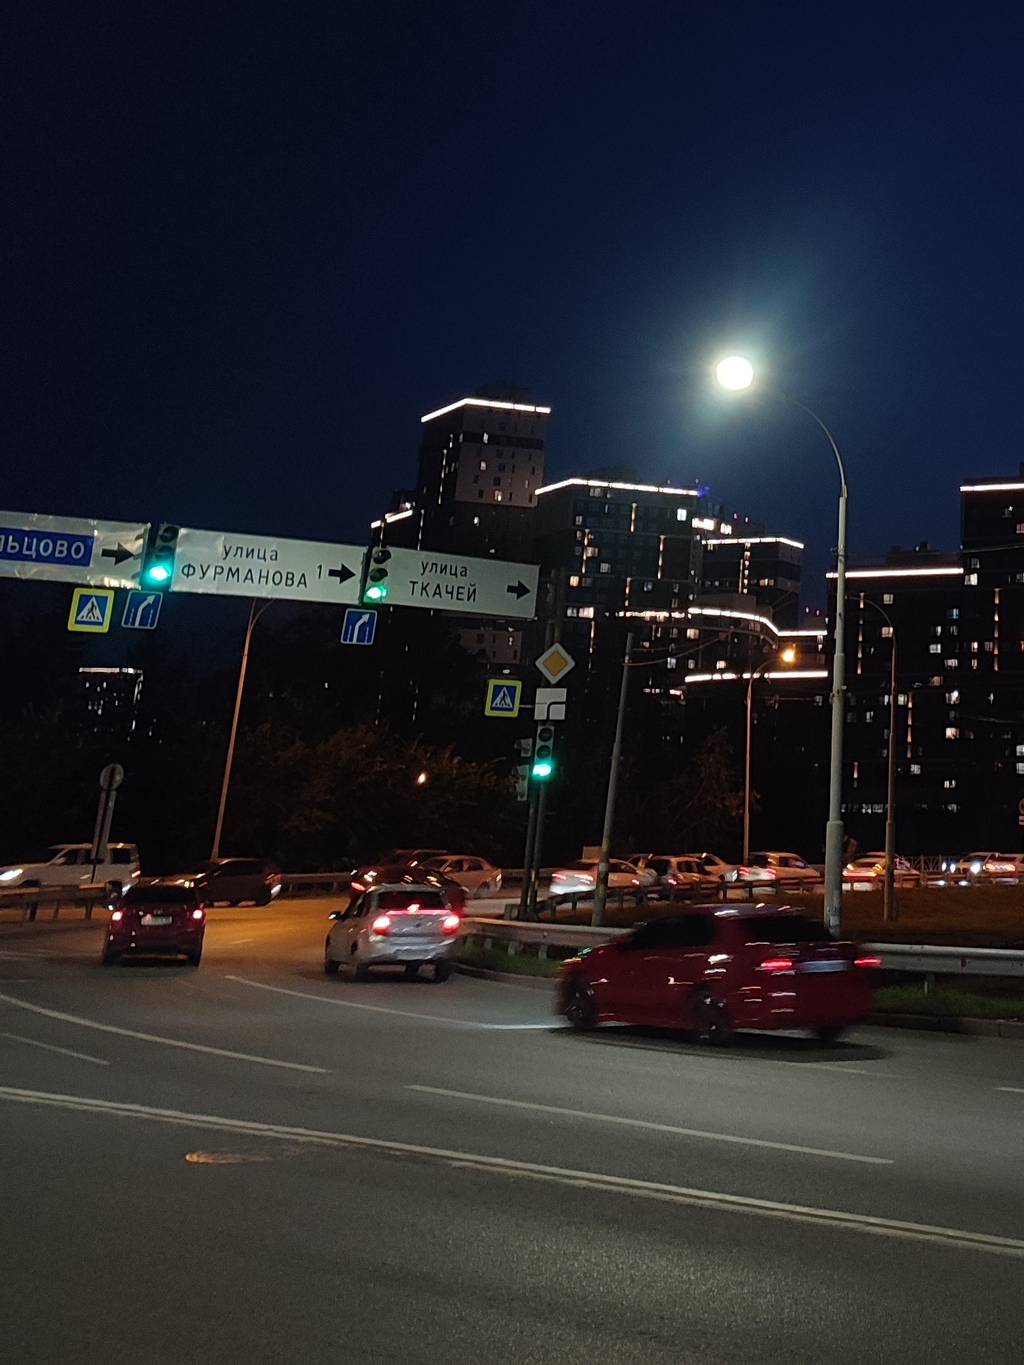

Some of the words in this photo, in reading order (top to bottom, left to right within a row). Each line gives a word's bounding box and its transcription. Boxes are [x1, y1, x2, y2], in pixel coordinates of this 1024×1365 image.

[222, 544, 279, 562] улица
[181, 562, 308, 589] ФУРМАНОВА
[316, 564, 323, 580] 1
[420, 561, 468, 578] улица
[409, 580, 477, 603] ТКАЧЕЙ
